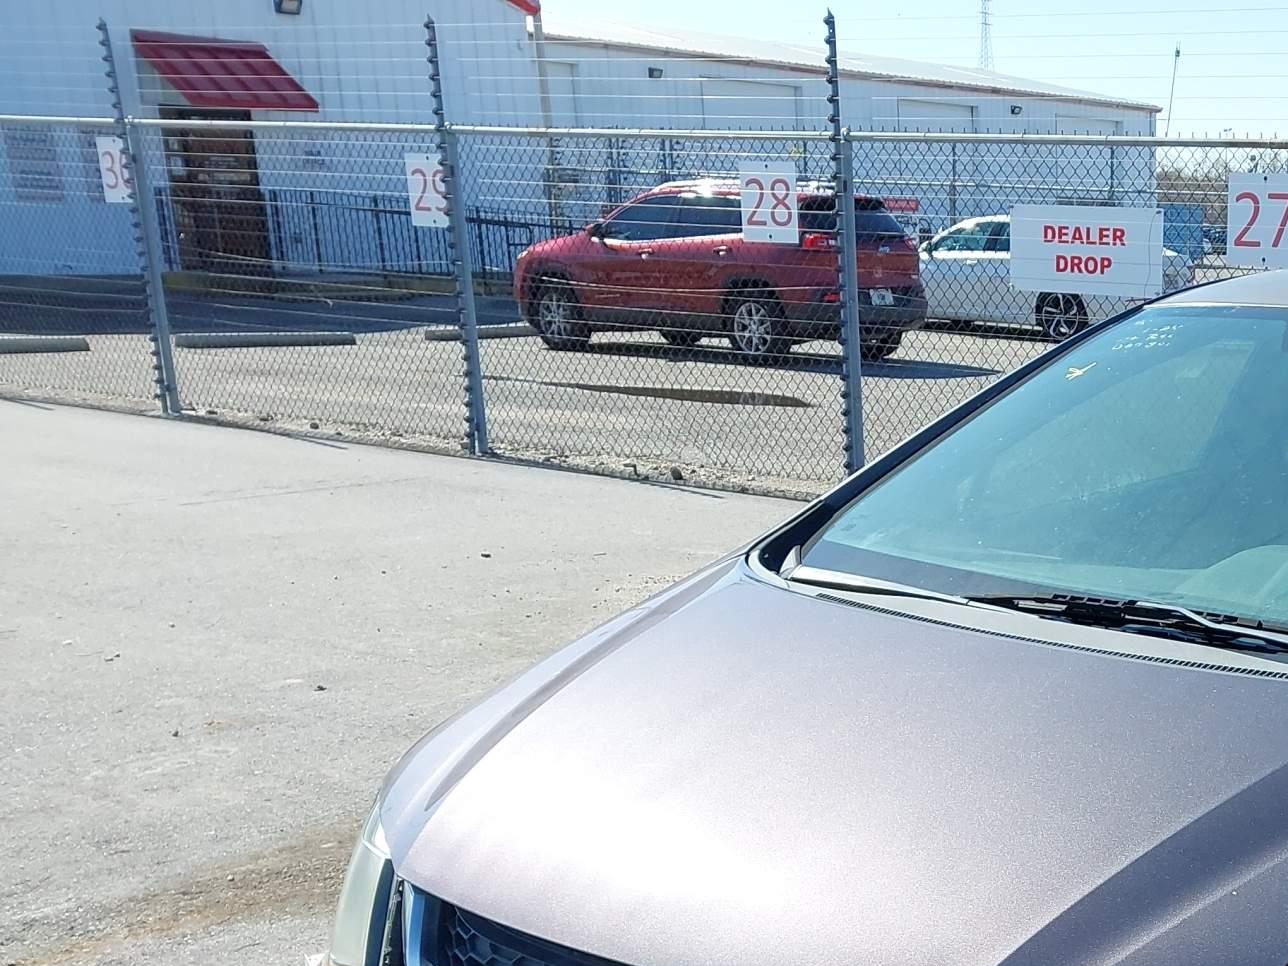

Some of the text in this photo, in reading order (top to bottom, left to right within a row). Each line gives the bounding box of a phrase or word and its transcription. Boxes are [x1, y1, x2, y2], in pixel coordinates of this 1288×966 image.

[745, 178, 793, 226] 28
[1043, 225, 1126, 247] DEALER
[1055, 254, 1112, 275] DROP
